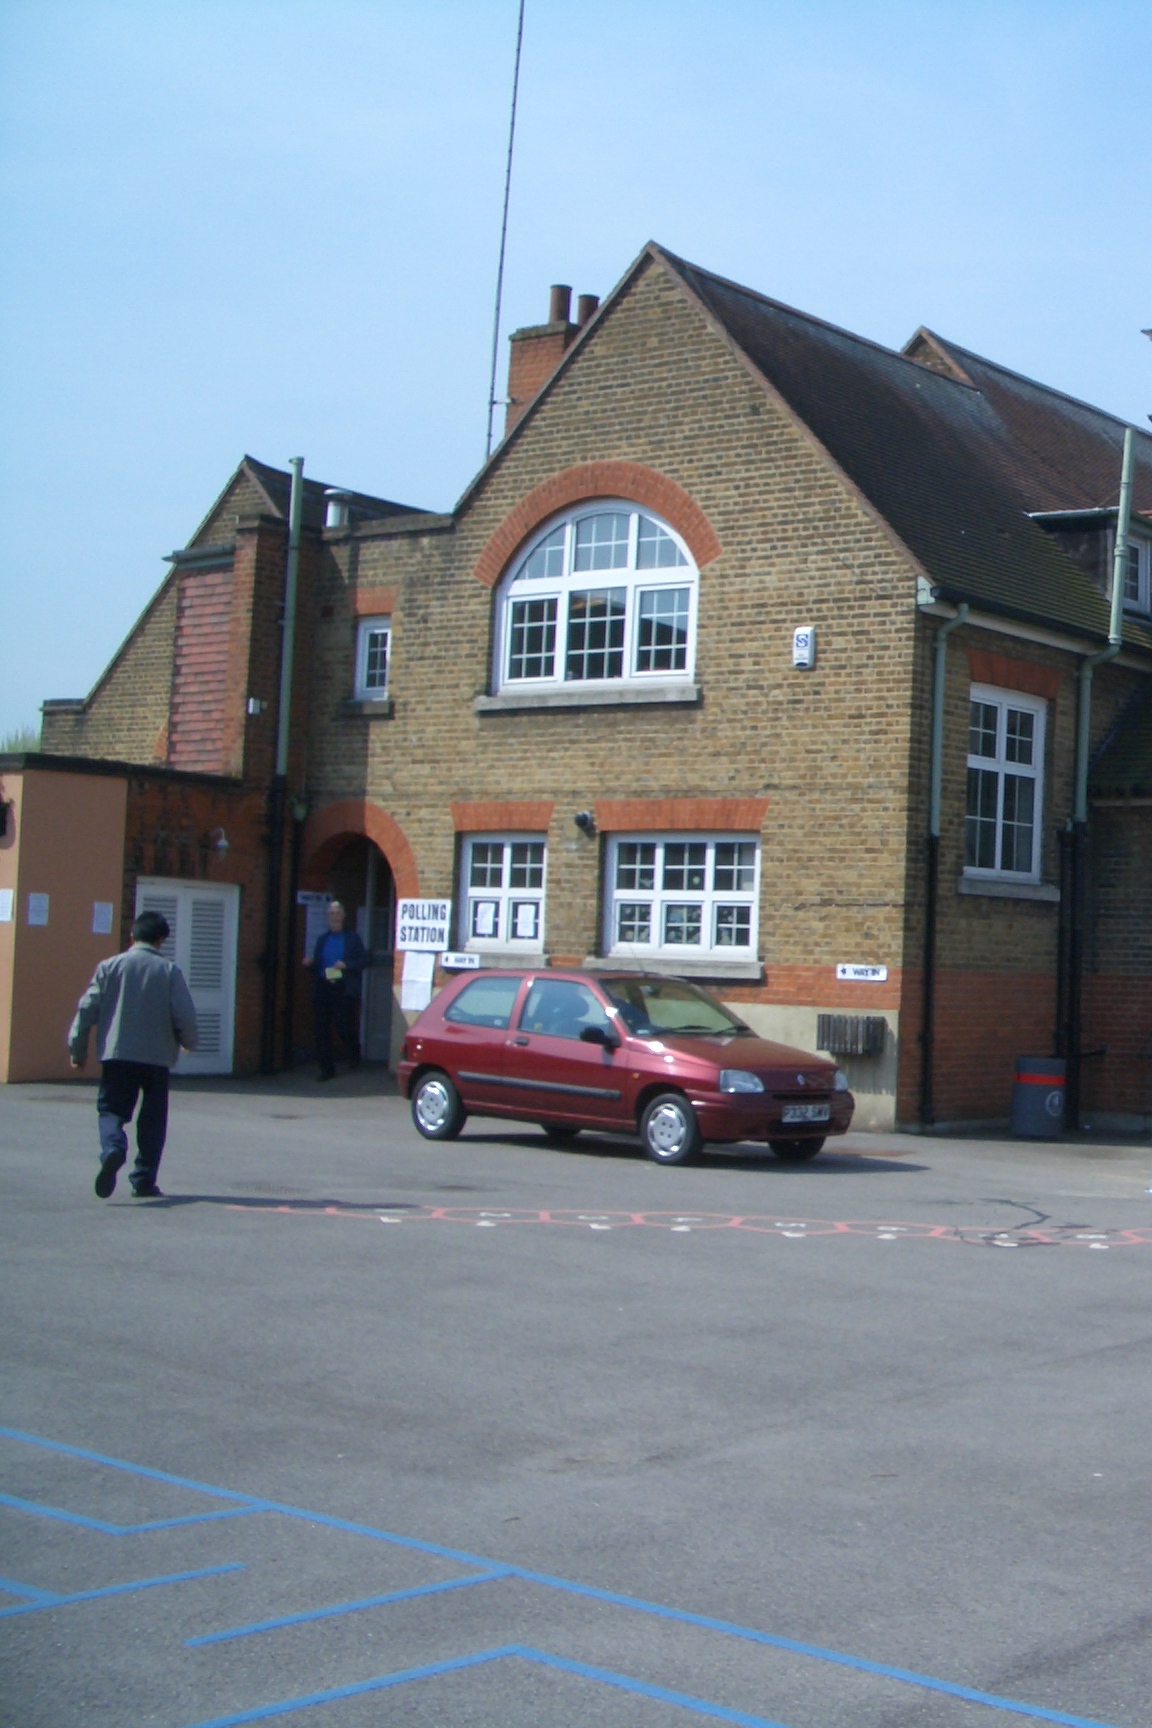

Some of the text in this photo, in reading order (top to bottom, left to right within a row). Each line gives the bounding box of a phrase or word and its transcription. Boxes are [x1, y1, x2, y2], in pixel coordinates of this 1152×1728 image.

[401, 903, 447, 920] POLLING
[400, 926, 445, 943] STATION
[852, 967, 869, 976] WAY
